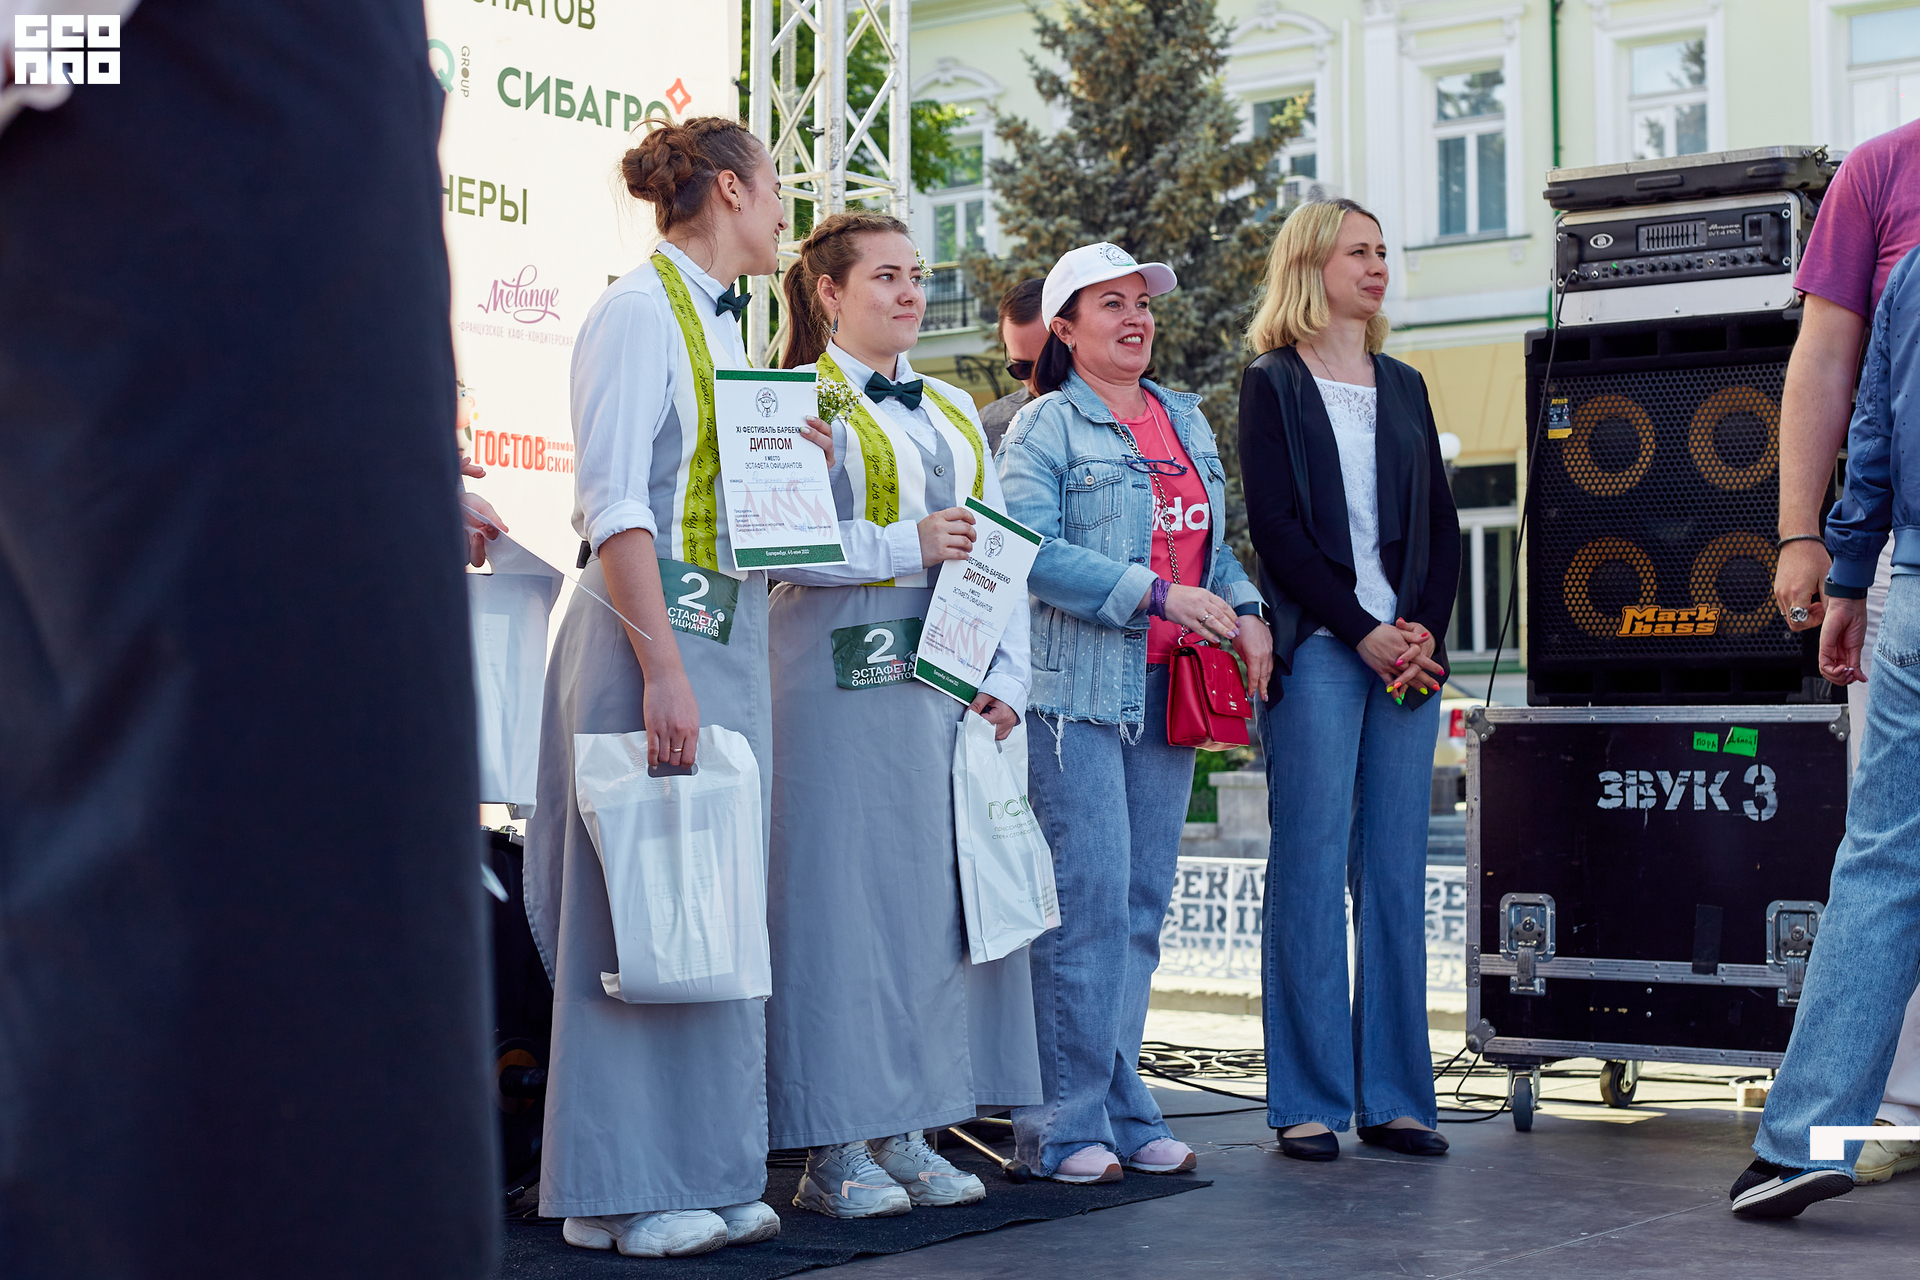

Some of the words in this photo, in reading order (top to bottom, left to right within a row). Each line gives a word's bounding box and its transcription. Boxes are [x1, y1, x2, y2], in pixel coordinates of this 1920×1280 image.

[461, 46, 470, 98] GROUP
[497, 67, 672, 132] СИБАГРО
[742, 426, 776, 434] ФЕСТИВАЛЬ
[777, 426, 801, 434] БАРБЕК
[750, 437, 793, 452] ДИПЛОМ
[474, 430, 547, 472] ГОСТОВ
[677, 572, 710, 612] 2
[963, 567, 997, 594] ДИПЛОМ
[989, 568, 1012, 585] БАРБЕКЮ
[1633, 621, 1716, 634] bass
[864, 628, 898, 664] 2
[851, 661, 914, 680] ЭСТАФЕТА
[1597, 770, 1730, 812] ЗВУК
[1742, 764, 1778, 822] 3
